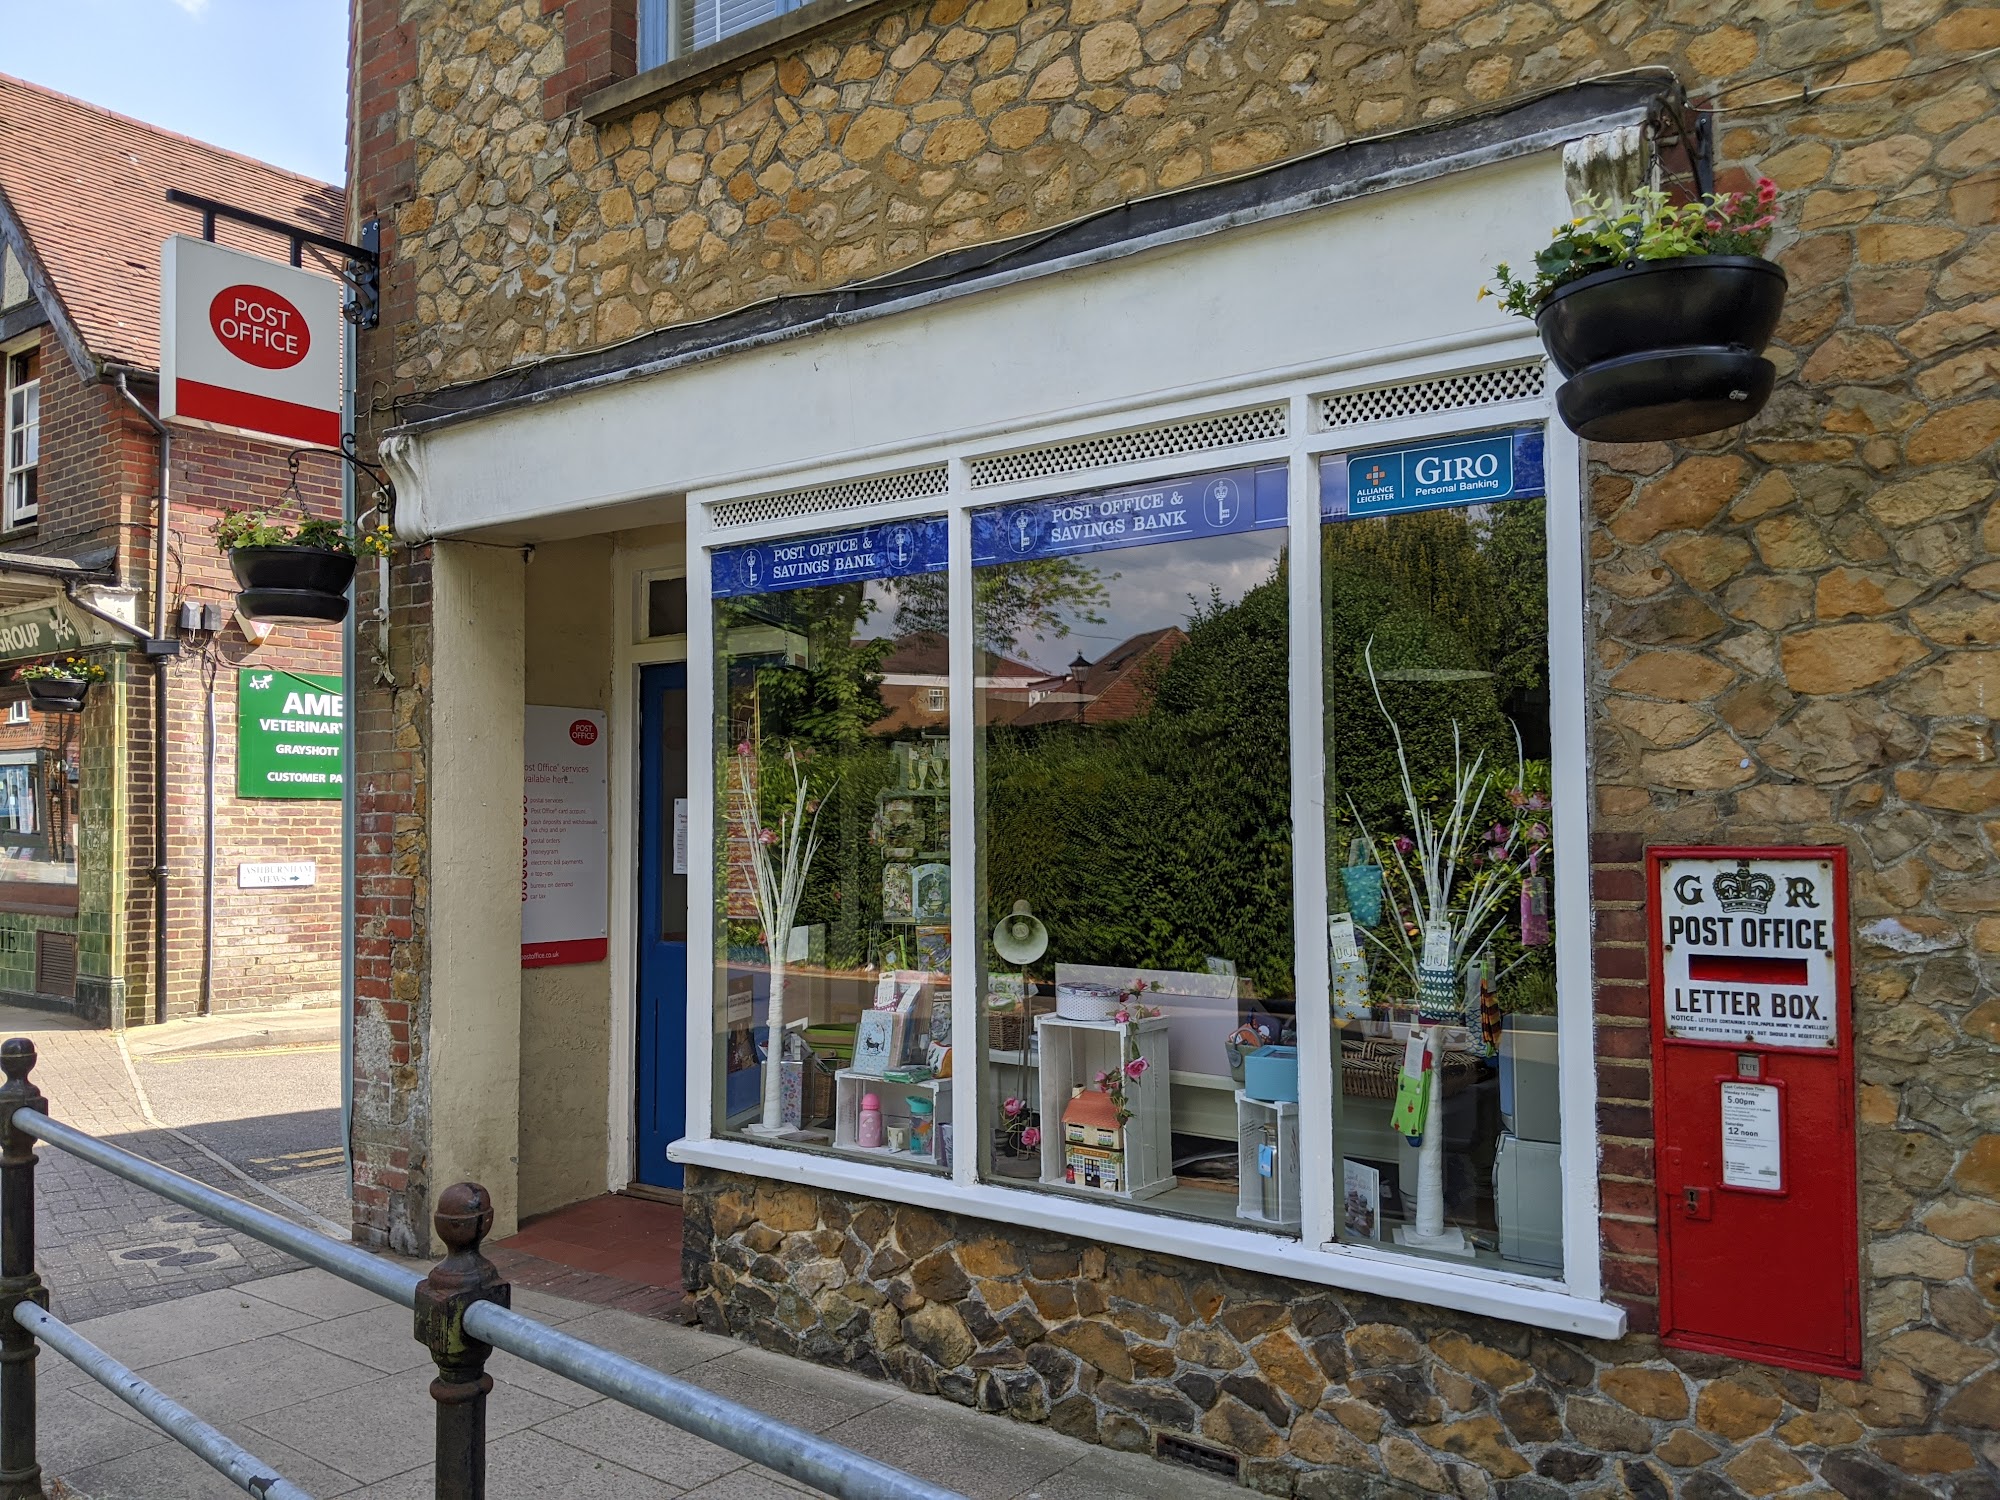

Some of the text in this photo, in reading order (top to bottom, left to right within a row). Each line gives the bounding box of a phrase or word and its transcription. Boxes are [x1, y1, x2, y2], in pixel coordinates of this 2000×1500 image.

[235, 298, 291, 329] POST
[220, 318, 298, 355] OFFICE
[1415, 453, 1498, 485] GIRO
[1357, 485, 1394, 496] ALLIANCE
[1415, 478, 1499, 496] Personal Banking
[1051, 491, 1184, 524] POST OFFICE &
[1356, 493, 1395, 504] LEICESTER
[1051, 510, 1187, 543] SAVINGS BANK
[773, 537, 873, 562] POST OFFICE &
[773, 553, 876, 579] SAVINGS BANK
[572, 732, 595, 740] OFFICE
[276, 744, 339, 756] GRAYSHOTT
[267, 772, 326, 783] CUSTOMER
[524, 775, 550, 783] vailable
[246, 866, 312, 874] ASHBURNHAM
[1673, 874, 1820, 909] G R
[1669, 916, 1828, 950] POST OFFICE
[1675, 988, 1828, 1021] LETTER BOX.
[1727, 1096, 1755, 1106] 5.00pm
[1728, 1127, 1739, 1135] 12
